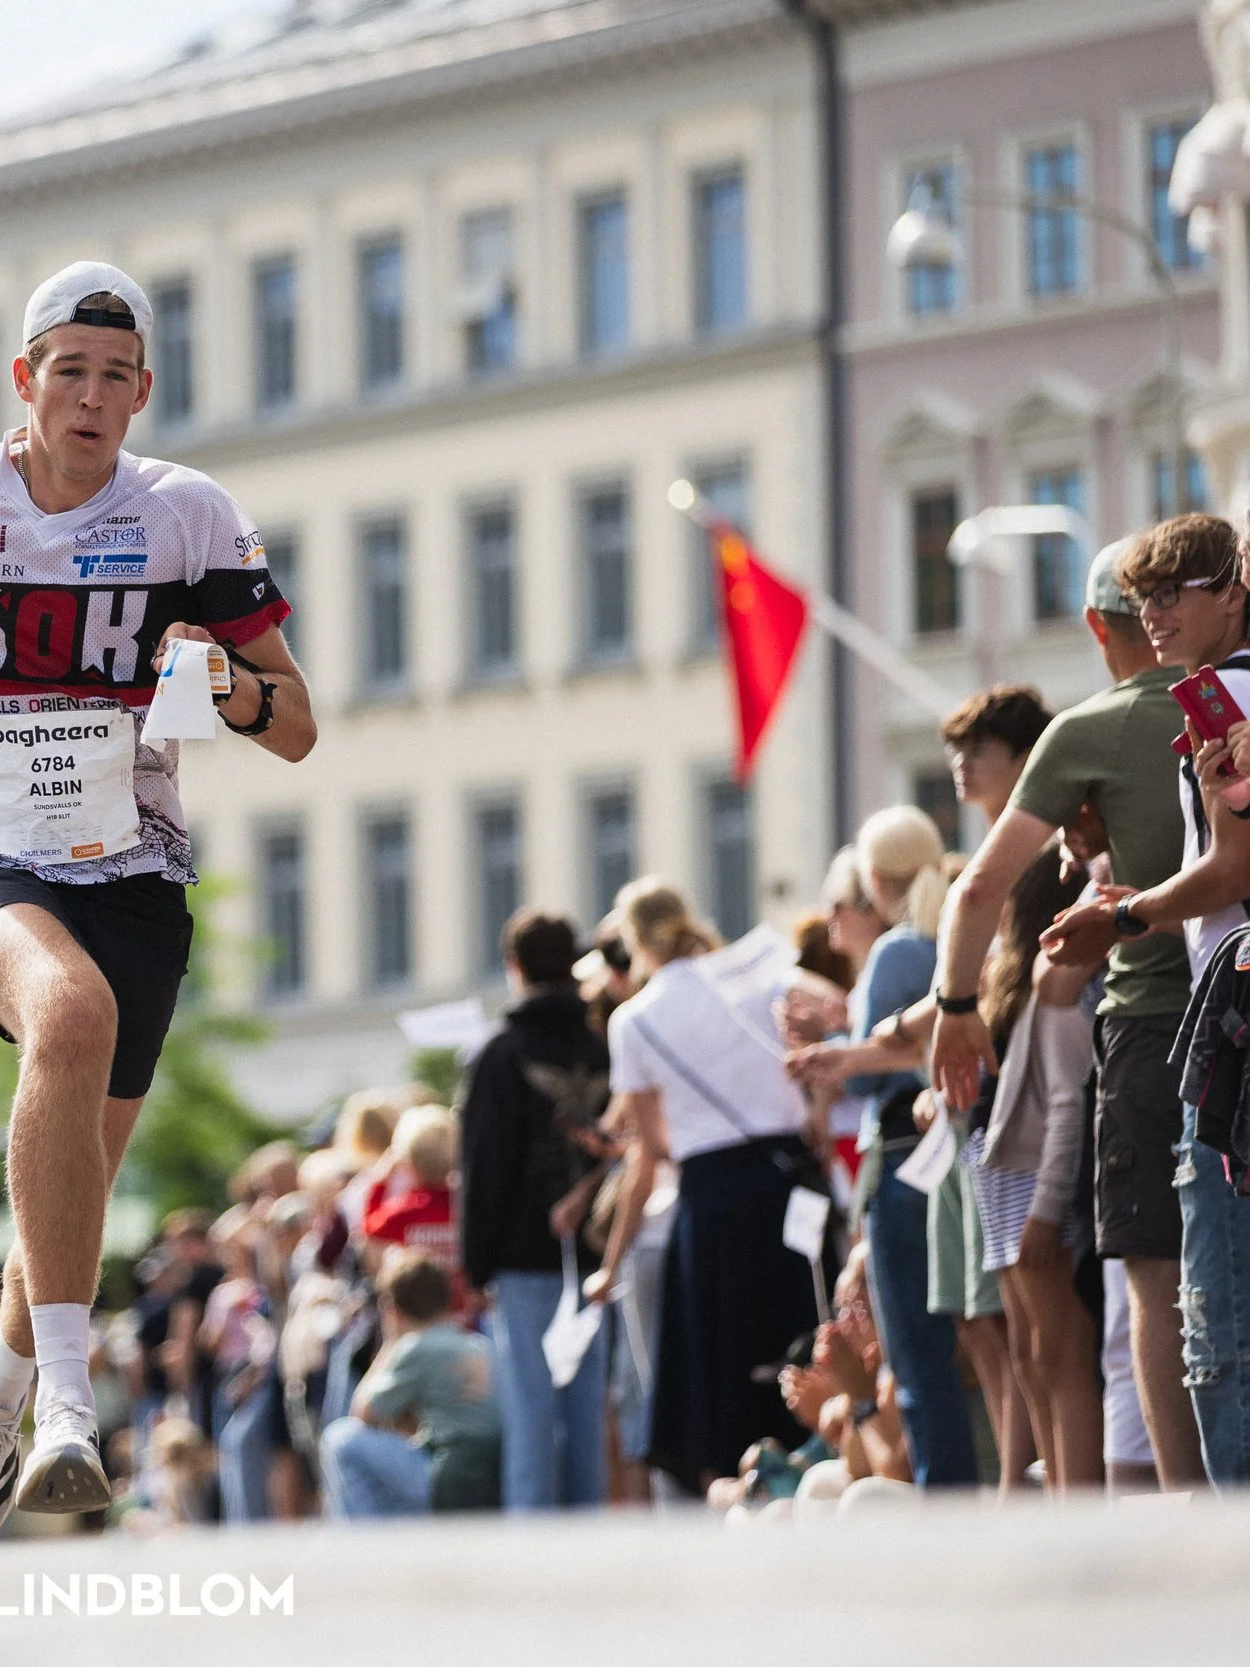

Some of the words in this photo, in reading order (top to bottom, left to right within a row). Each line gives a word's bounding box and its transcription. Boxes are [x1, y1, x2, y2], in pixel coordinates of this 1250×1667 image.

[97, 564, 146, 574] SERVICE
[31, 755, 76, 773] 6784
[29, 779, 82, 797] ALBIN
[33, 802, 71, 810] SUNDSVALLS
[20, 849, 62, 857] CHALMERS
